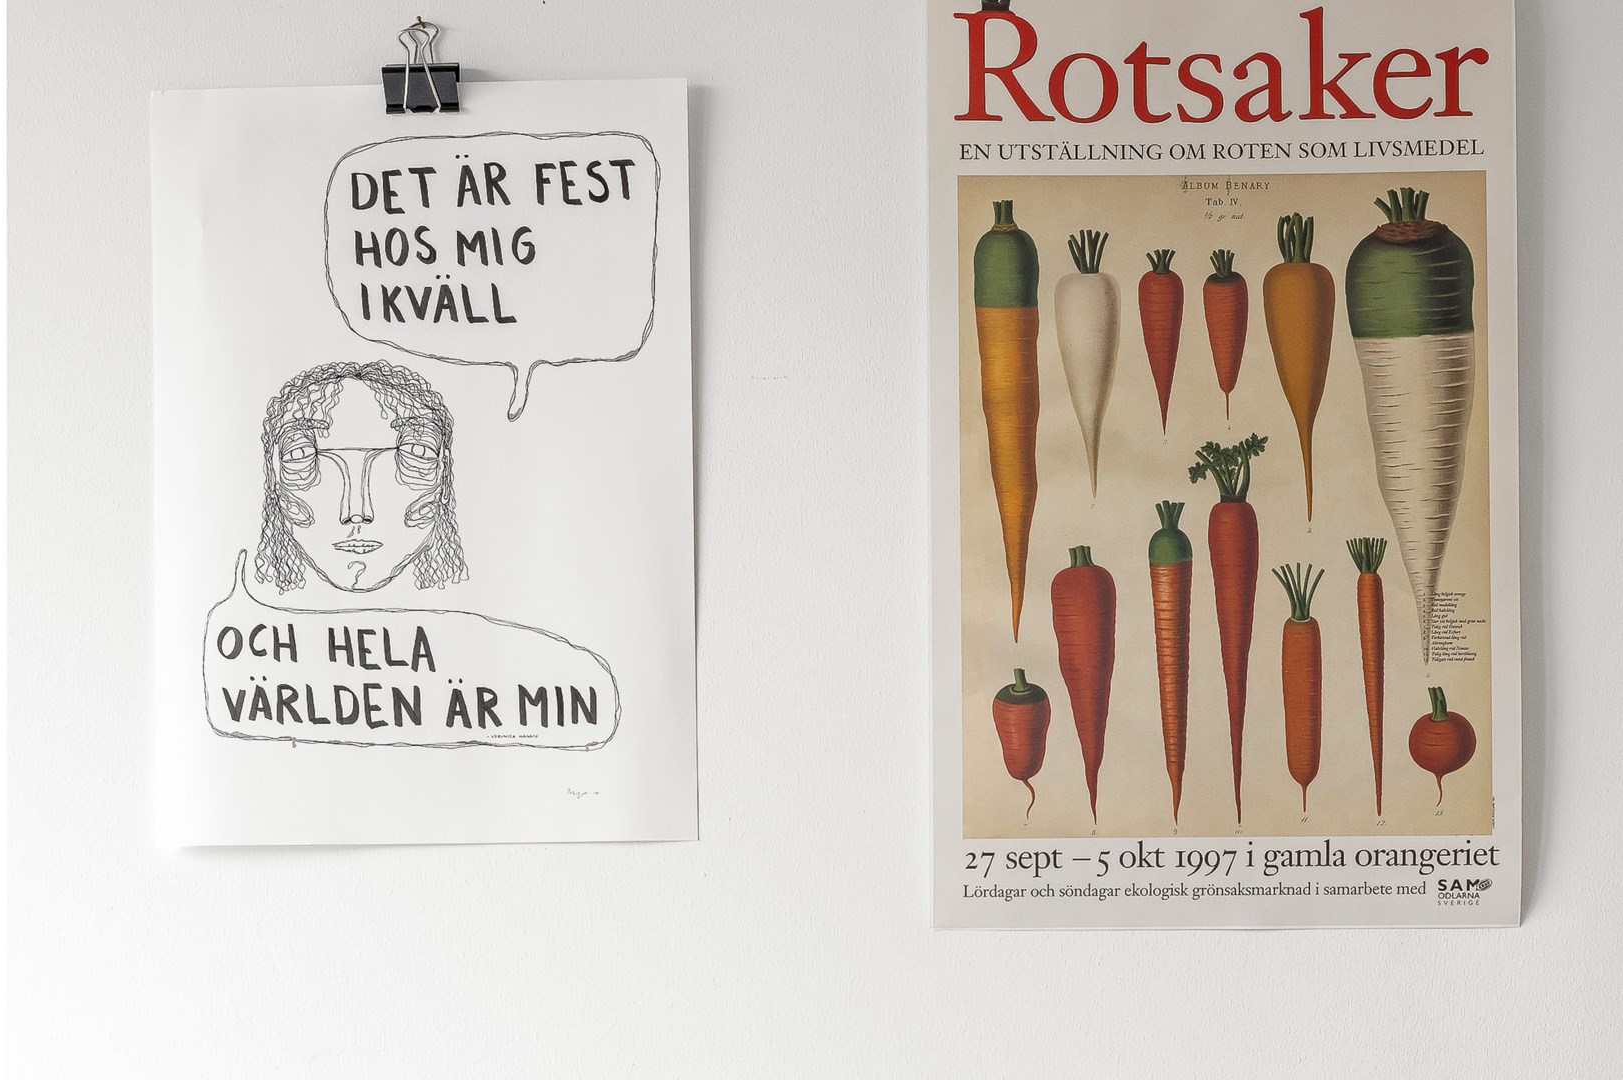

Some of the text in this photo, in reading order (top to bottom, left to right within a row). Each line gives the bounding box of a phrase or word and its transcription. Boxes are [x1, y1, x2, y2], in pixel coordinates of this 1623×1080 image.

[953, 6, 1490, 123] Rotsaker
[960, 140, 1484, 160] EN UTSTÄLLNING OM ROTEN SOM LIVSMEDEL
[352, 155, 635, 214] DET ÄR FEST
[355, 226, 535, 268] HOS MIG
[217, 624, 435, 672] OCH HELA
[221, 676, 597, 730] VÄRLDEN ÄR MIN
[966, 852, 995, 878] 27
[1006, 849, 1062, 878] sept
[1120, 841, 1165, 868] okt
[1176, 850, 1237, 876] 1997
[1247, 841, 1253, 867] i
[1264, 839, 1346, 876] gamla
[1356, 840, 1499, 875] orangeriet
[964, 881, 1426, 901] Lördagar och söndagar ekologisk grönsaksmarknad i samarbete med
[1438, 892, 1480, 900] ODLARNA
